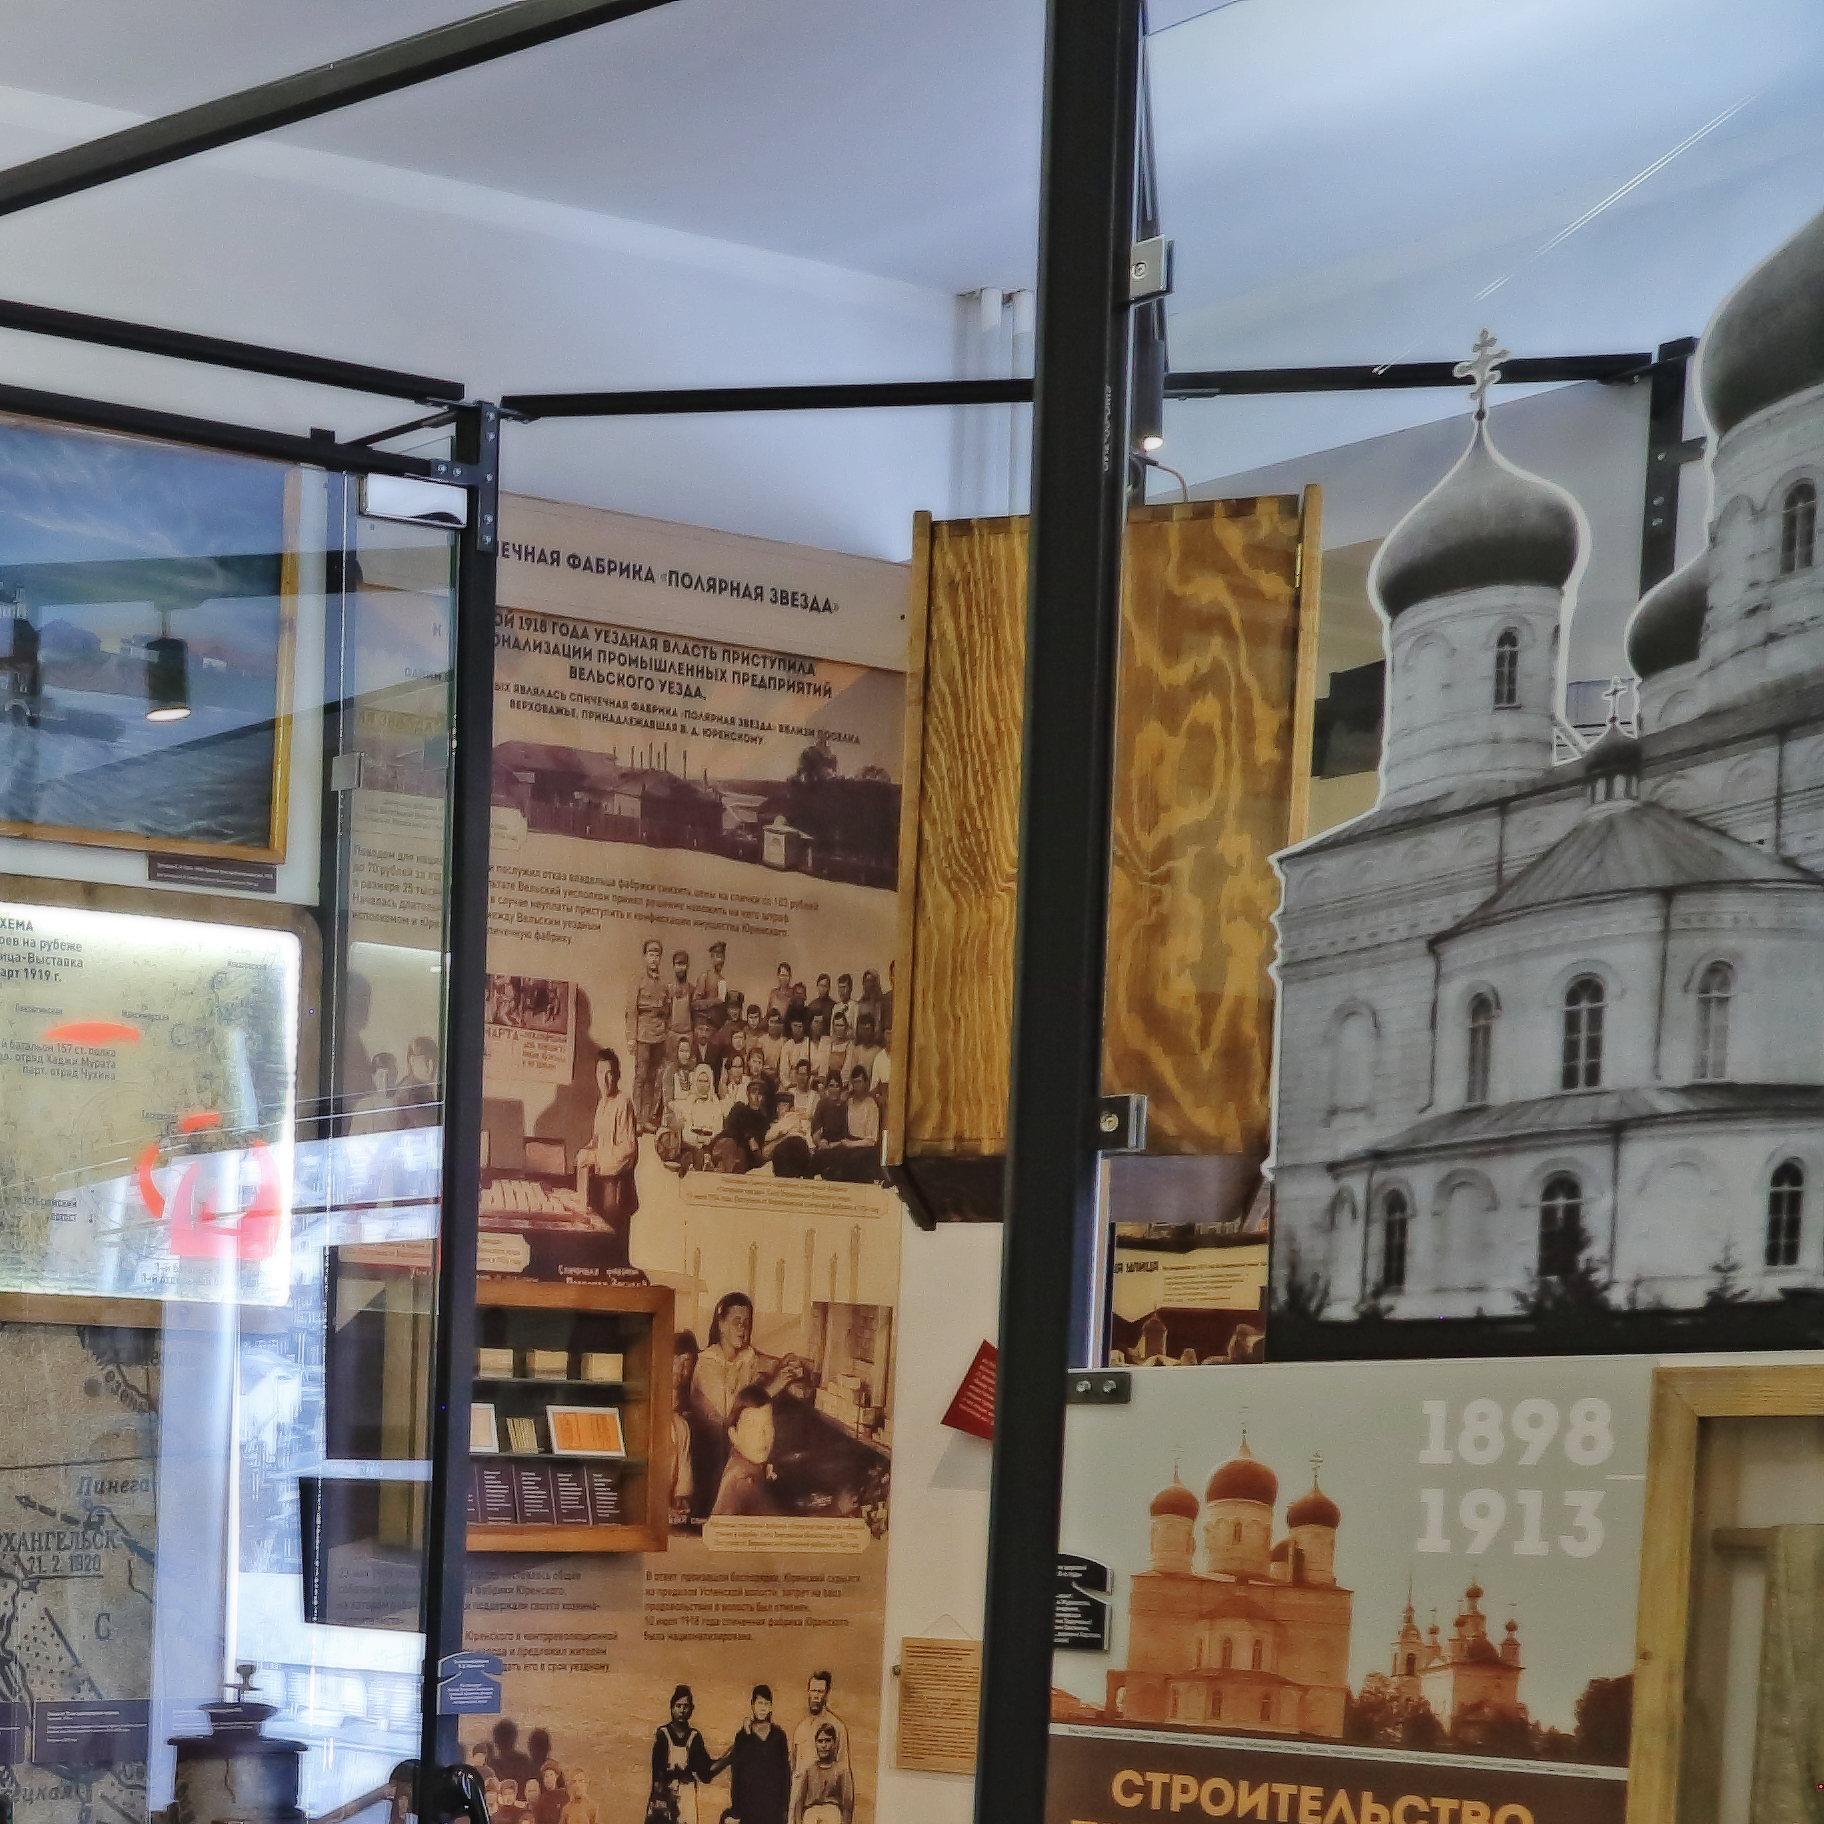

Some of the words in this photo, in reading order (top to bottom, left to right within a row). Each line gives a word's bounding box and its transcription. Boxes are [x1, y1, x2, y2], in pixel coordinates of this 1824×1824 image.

[497, 541, 561, 567] ЕЧНАЯ
[566, 553, 655, 583] ФАБРИКА
[519, 615, 547, 633] 1918
[552, 621, 589, 641] ГОДА
[594, 628, 658, 652] УЕЗДНАЯ
[663, 640, 717, 660] ВЛАСТЬ
[722, 649, 816, 676] ПРИСТУПИЛА
[569, 665, 654, 691] ВЕЛЬСКОГО
[598, 649, 727, 683] ПРОМЫШЛЕННЫХ
[732, 669, 832, 698] ПРЕДПРИЯТИЙ
[23, 937, 36, 948] на
[40, 940, 82, 952] рубеже
[24, 967, 51, 980] 1919
[54, 971, 62, 982] г.
[1418, 1398, 1614, 1465] 1898
[1417, 1489, 1606, 1558] 1913
